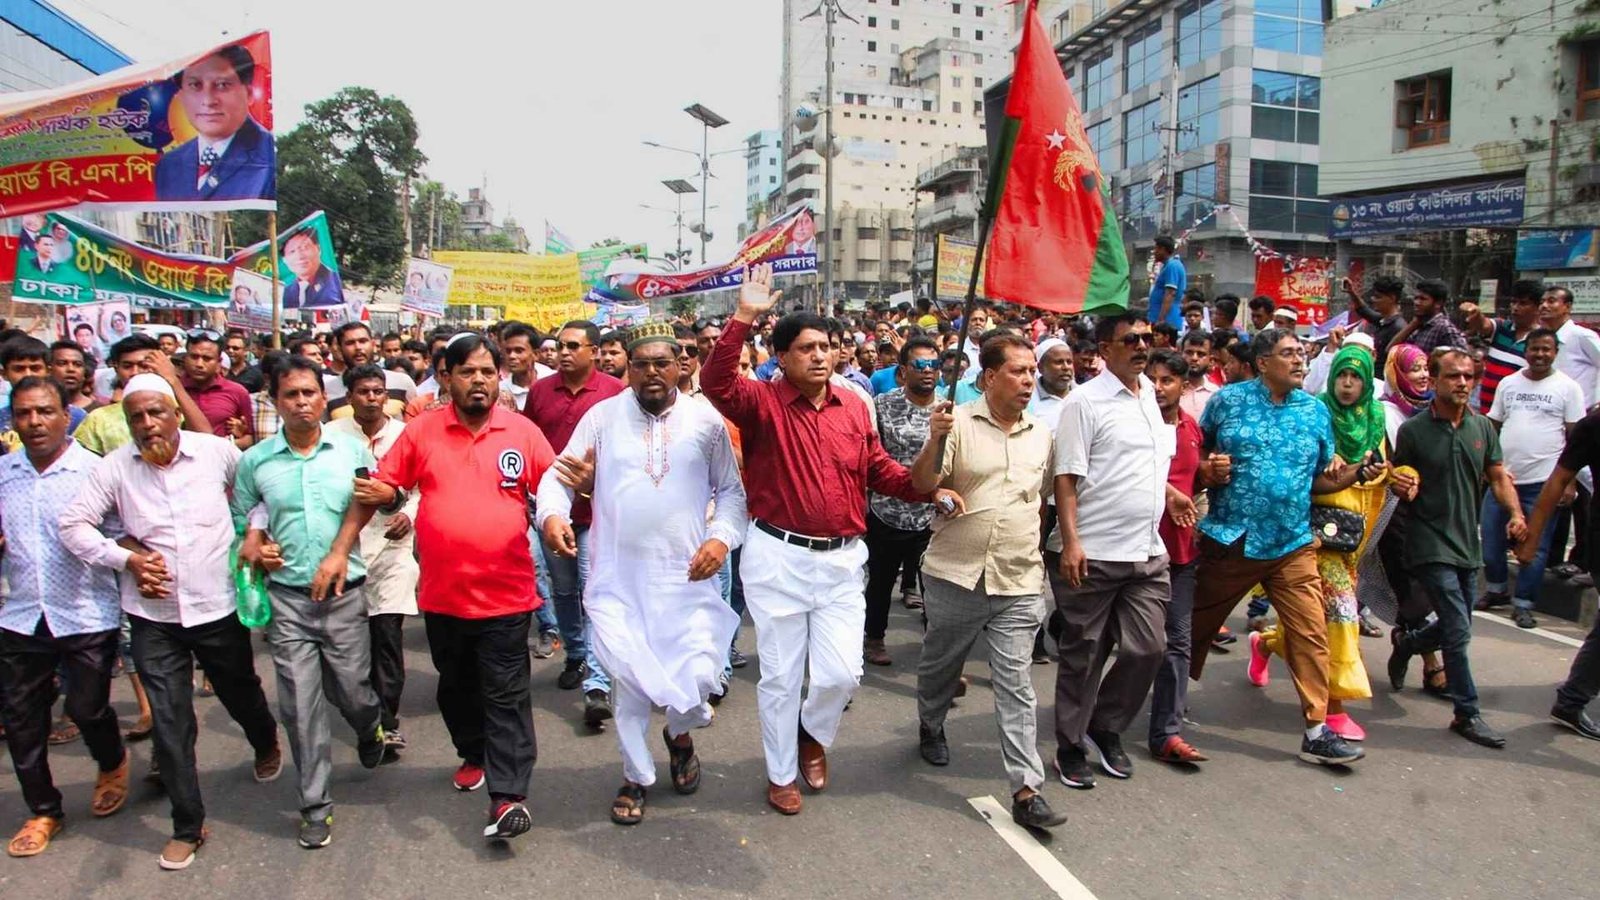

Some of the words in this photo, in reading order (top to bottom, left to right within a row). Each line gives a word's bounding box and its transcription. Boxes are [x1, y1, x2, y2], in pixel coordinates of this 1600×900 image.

[97, 98, 151, 129] হউক
[48, 155, 156, 190] বি.এন.পি
[1352, 204, 1366, 218] ১৩
[1368, 202, 1383, 217] নং
[1386, 192, 1416, 214] ওয়ার্ড
[1475, 183, 1526, 205] কার্যালয়
[19, 278, 84, 301] ঢাকা
[142, 260, 199, 293] ওয়ার্ড
[1516, 392, 1552, 404] ORIGINAL
